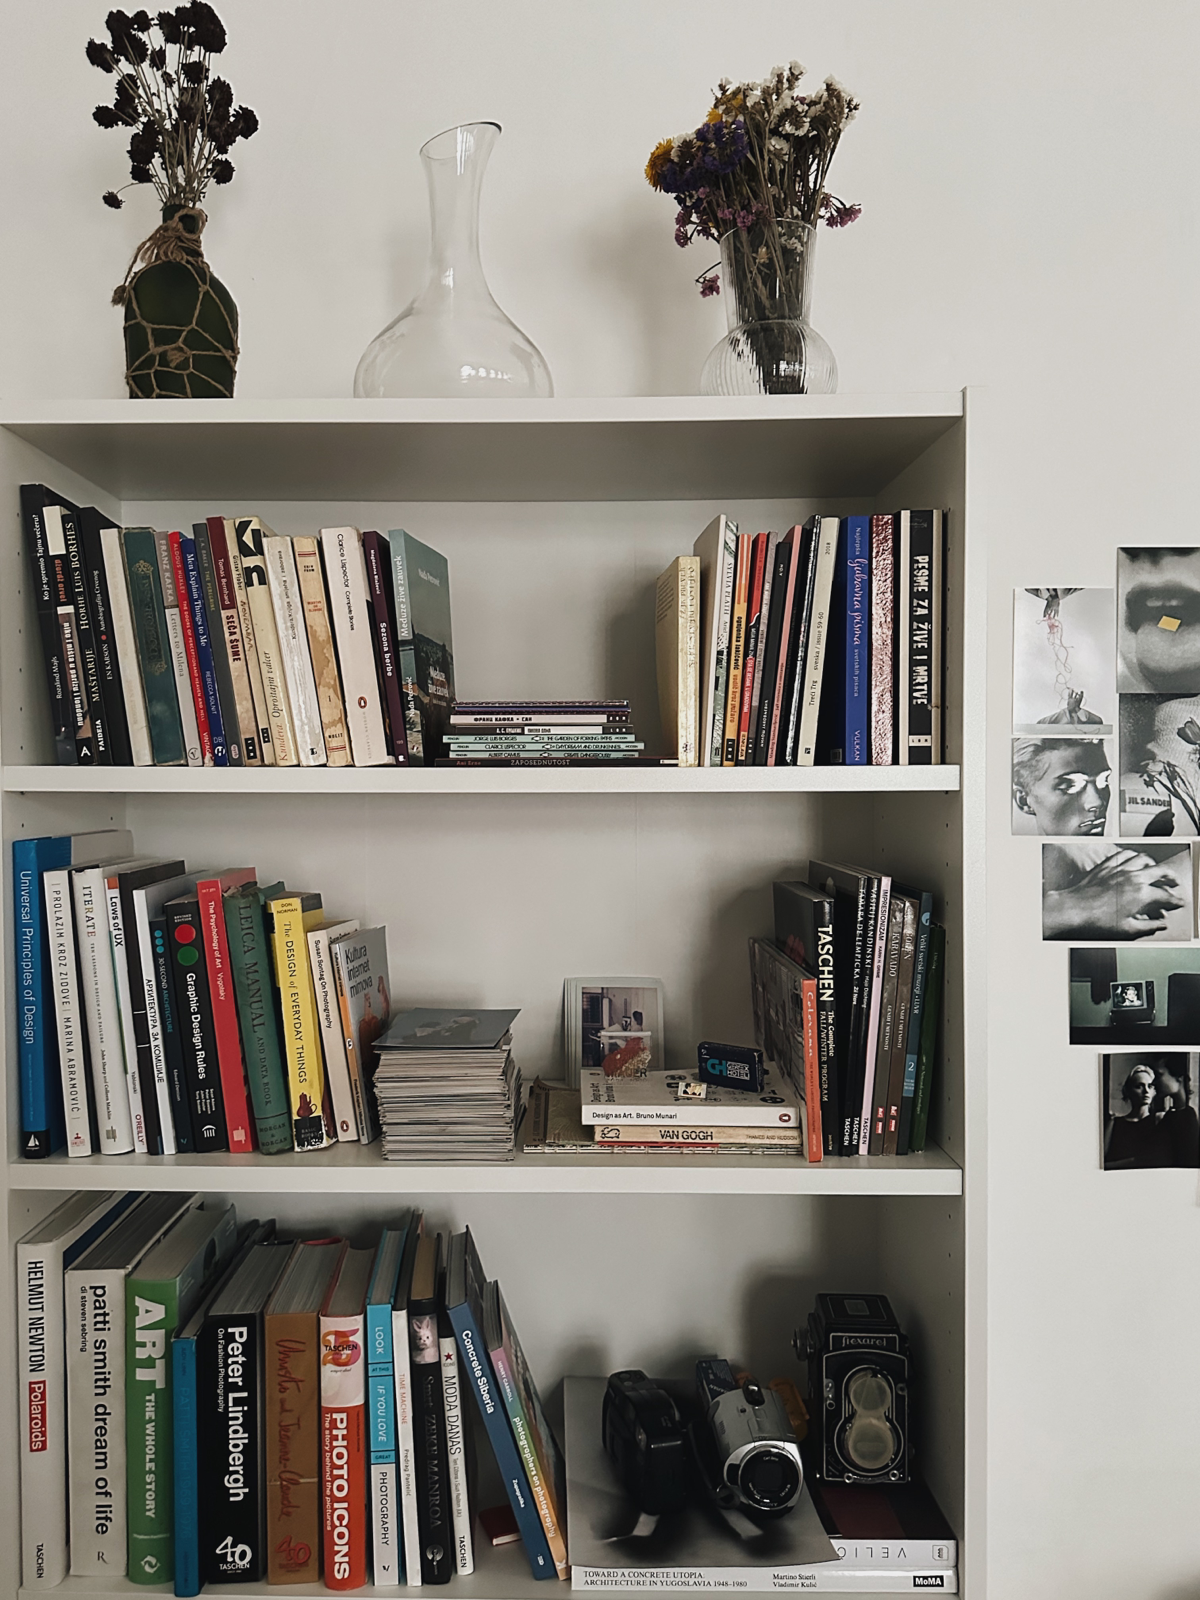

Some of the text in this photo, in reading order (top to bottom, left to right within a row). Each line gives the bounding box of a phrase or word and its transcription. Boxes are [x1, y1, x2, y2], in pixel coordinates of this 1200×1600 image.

[65, 522, 90, 630] HORHE LUIS BORHES
[160, 540, 174, 602] FRANZ KAFKA
[337, 534, 349, 588] Clarice Lispector
[914, 555, 929, 592] PESME
[394, 555, 409, 637] Meduze žive zauvek
[847, 558, 868, 608] ljubavna
[848, 611, 864, 645] pisma
[913, 599, 928, 616] ZA
[230, 638, 241, 663] ŠUME
[380, 622, 393, 677] Sezona berbe
[913, 622, 931, 649] ŽIVE
[52, 673, 62, 699] Rozalind
[84, 648, 100, 702] MAŠTARIJE
[913, 666, 928, 705] MRTVE
[208, 696, 217, 715] SOLNIT
[262, 651, 288, 761] Kundera Oproštajni valcer
[96, 720, 105, 751] PAIDEIA
[1128, 797, 1139, 805] JIL
[20, 871, 33, 923] Universal
[82, 886, 96, 937] ITERATE
[858, 889, 866, 922] TAMARA
[877, 889, 889, 941] IMPRESIONIZAM
[110, 896, 123, 948] Laws of UX
[284, 921, 294, 937] The
[21, 928, 34, 985] Principles
[52, 890, 70, 1005] PROLAZIM KROZ ZIDOVE
[286, 940, 296, 978] DESIGN
[345, 945, 367, 965] Kultura
[818, 924, 834, 1001] TASCHEN
[853, 935, 863, 978] LEMPICKA
[346, 960, 370, 981] internet
[350, 976, 373, 998] mimova
[24, 988, 36, 1001] of
[158, 957, 173, 1032] 30-SECOND ARCHITECTURE
[239, 904, 271, 1106] LEICA MANUAL AND DATA BOOK
[23, 1006, 36, 1044] Design
[146, 979, 165, 1083] АРХИТЕКТУРА ЗА КОМШИЈЕ
[186, 973, 206, 1080] Graphic Design Rules
[291, 992, 303, 1041] EVERYDAY
[820, 1011, 828, 1062] FALL/WINTER
[64, 1017, 81, 1112] MARINA ABRAMOVIĆ
[296, 1045, 307, 1084] THINGS
[660, 1130, 713, 1140] VAN GOGH
[218, 1328, 224, 1339] On
[324, 1344, 358, 1352] TASCHEN
[375, 1327, 384, 1354] LOOK
[28, 1260, 46, 1450] HELMUT NEWTON Polaroids
[462, 1330, 494, 1414] Concrete Siberia
[444, 1376, 458, 1412] MODA
[498, 1360, 514, 1402] HENRY CARROLL
[89, 1285, 112, 1534] patti smith dream of life
[135, 1296, 166, 1518] ART THE WHOLE STORY
[224, 1327, 249, 1501] Peter Lindbergh
[377, 1386, 386, 1442] IF YOU LOVE
[448, 1415, 461, 1456] DANAS
[333, 1412, 350, 1580] PHOTO ICONS
[512, 1416, 556, 1537] photographers on photography
[379, 1472, 389, 1546] PHOTOGRAPHY
[36, 1543, 44, 1579] TASCHEN
[215, 1536, 252, 1565] 40
[274, 1535, 311, 1564] 40
[459, 1535, 467, 1568] TASCHEN
[673, 1571, 705, 1579] UTOPIA:
[915, 1577, 942, 1586] MoMA
